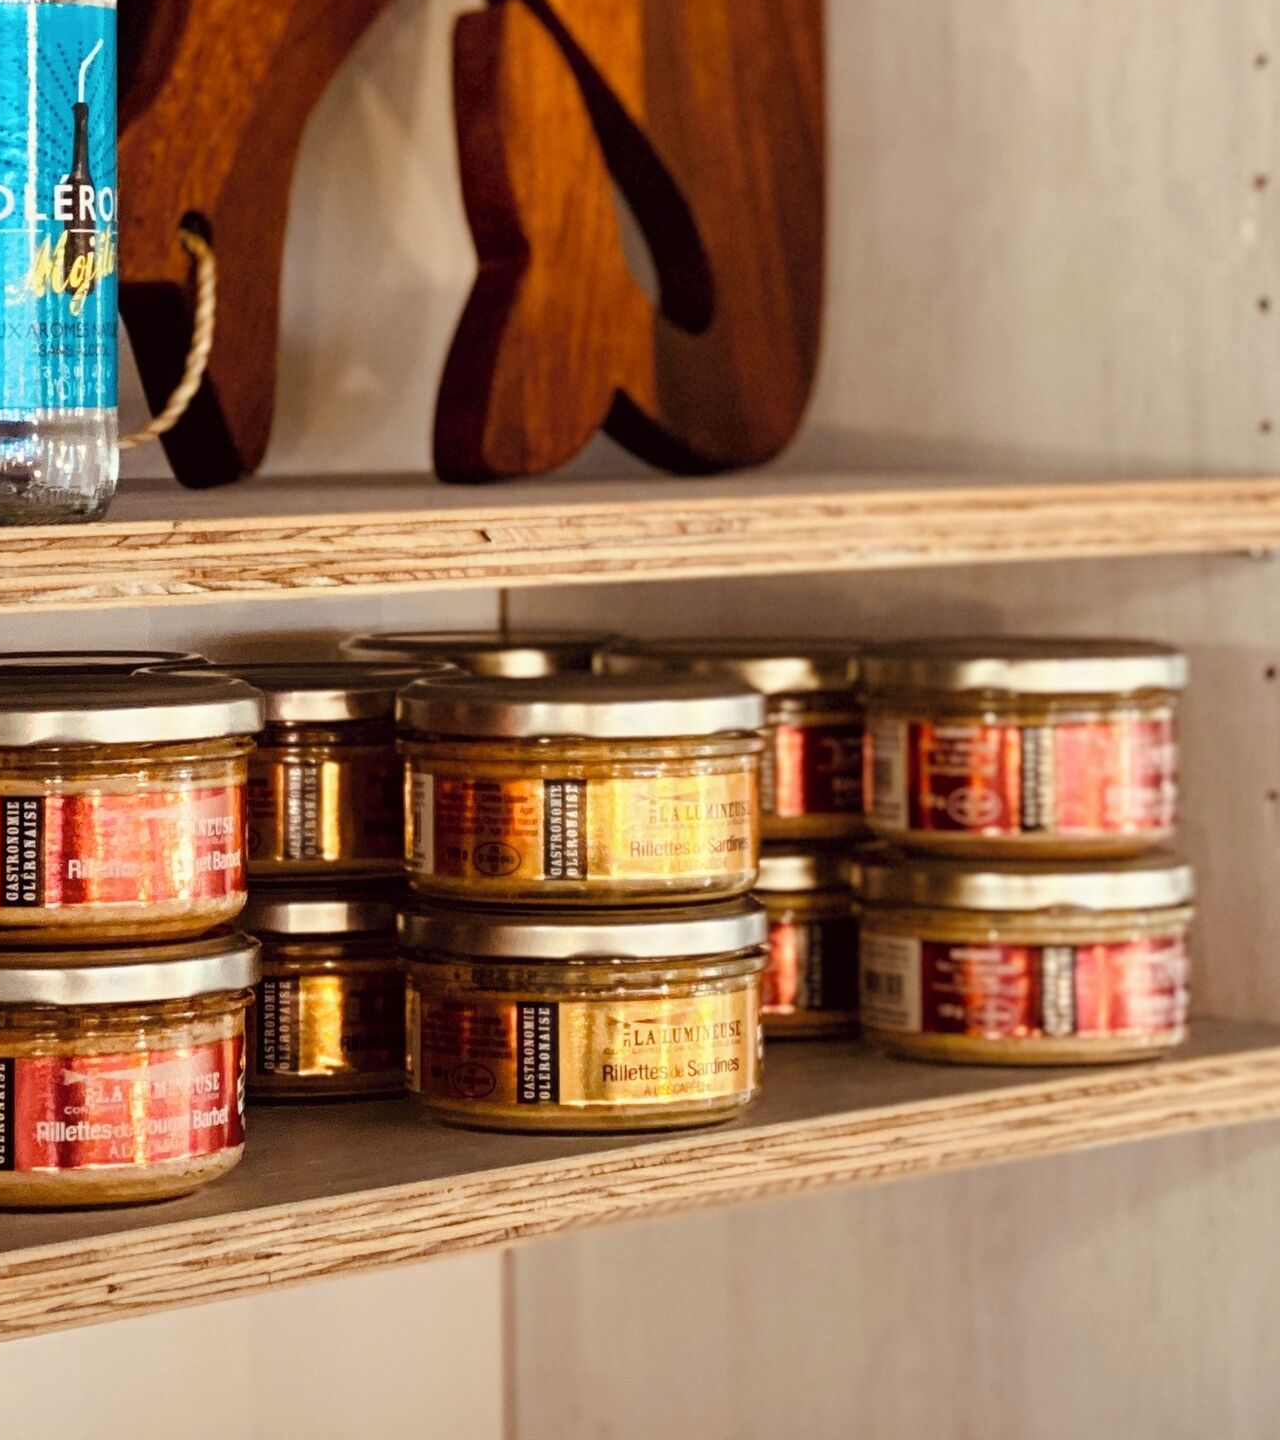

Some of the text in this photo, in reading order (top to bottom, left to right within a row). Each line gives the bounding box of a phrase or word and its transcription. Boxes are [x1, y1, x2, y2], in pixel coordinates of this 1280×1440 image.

[6, 801, 20, 902] GASTRONOMIE
[22, 800, 38, 902] OLÉRONAISE
[549, 784, 563, 877] GASTRONOMIE
[565, 783, 579, 878] OLÉRONAISE
[629, 839, 690, 858] Rillettes
[523, 1007, 535, 1100] GASTRONOMIE
[538, 1007, 551, 1100] OLÉRONAISE
[601, 1063, 669, 1082] Rillettes
[687, 1056, 740, 1078] Sardines
[634, 1019, 742, 1046] LA LUMINEUSE
[36, 1120, 113, 1144] Rillettes
[192, 1104, 229, 1129] Barbet
